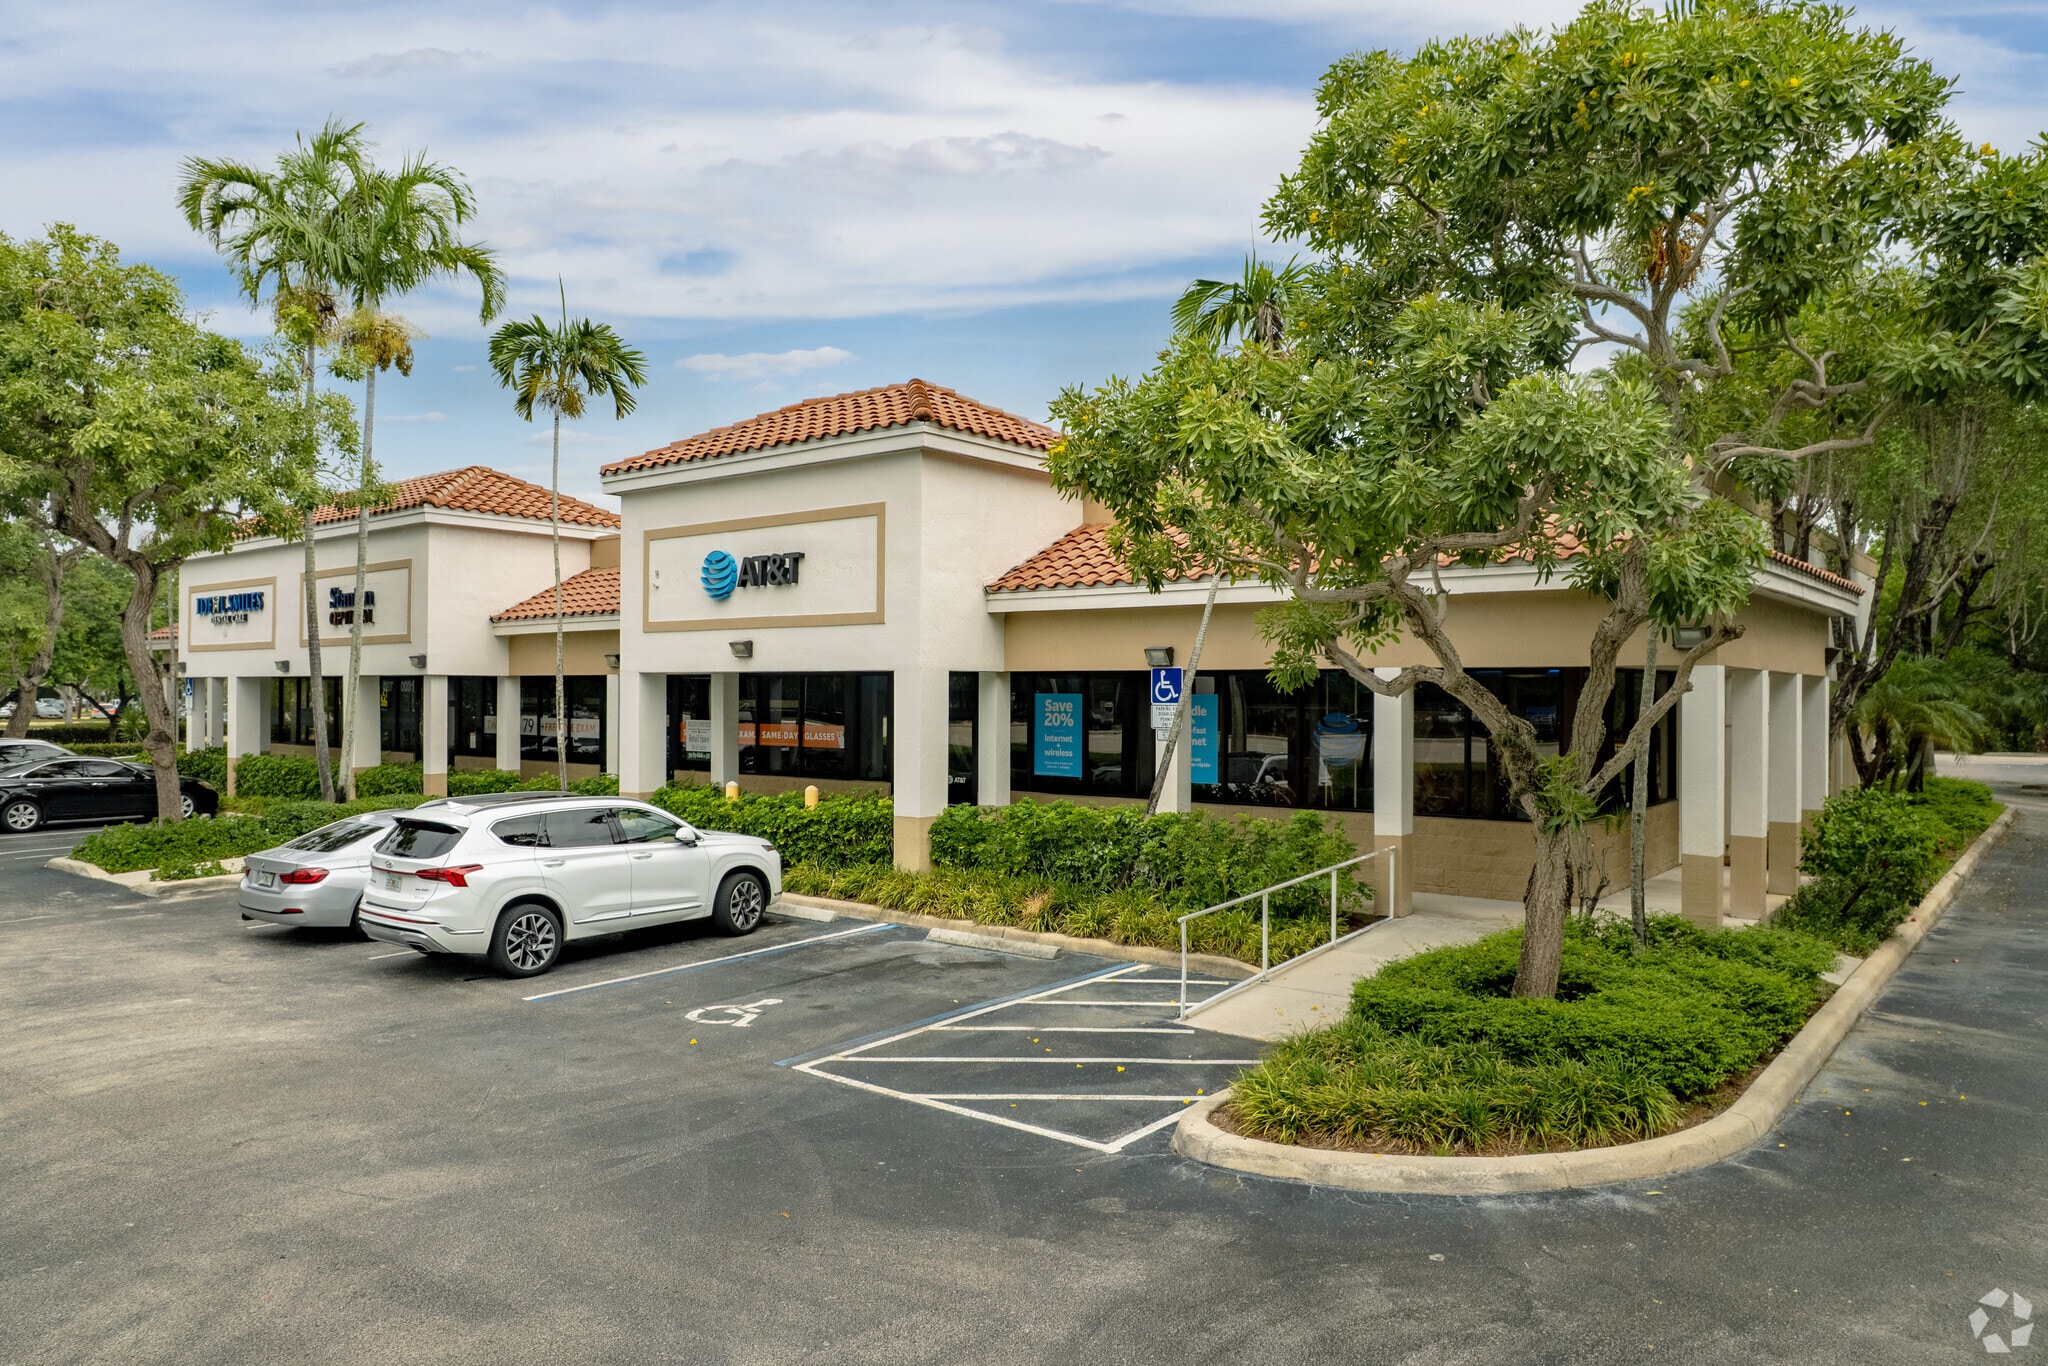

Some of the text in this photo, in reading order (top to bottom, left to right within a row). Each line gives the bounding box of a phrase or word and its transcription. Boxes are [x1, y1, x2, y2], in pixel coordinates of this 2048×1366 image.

[737, 552, 805, 587] AT&T
[228, 592, 264, 613] SMILES
[1045, 699, 1073, 712] Save
[1044, 712, 1074, 727] 20%
[576, 723, 596, 733] EXAM
[762, 731, 799, 740] SAME-DAY
[804, 732, 835, 741] GLASSES
[1044, 734, 1073, 743] internet
[1044, 748, 1073, 757] wireless
